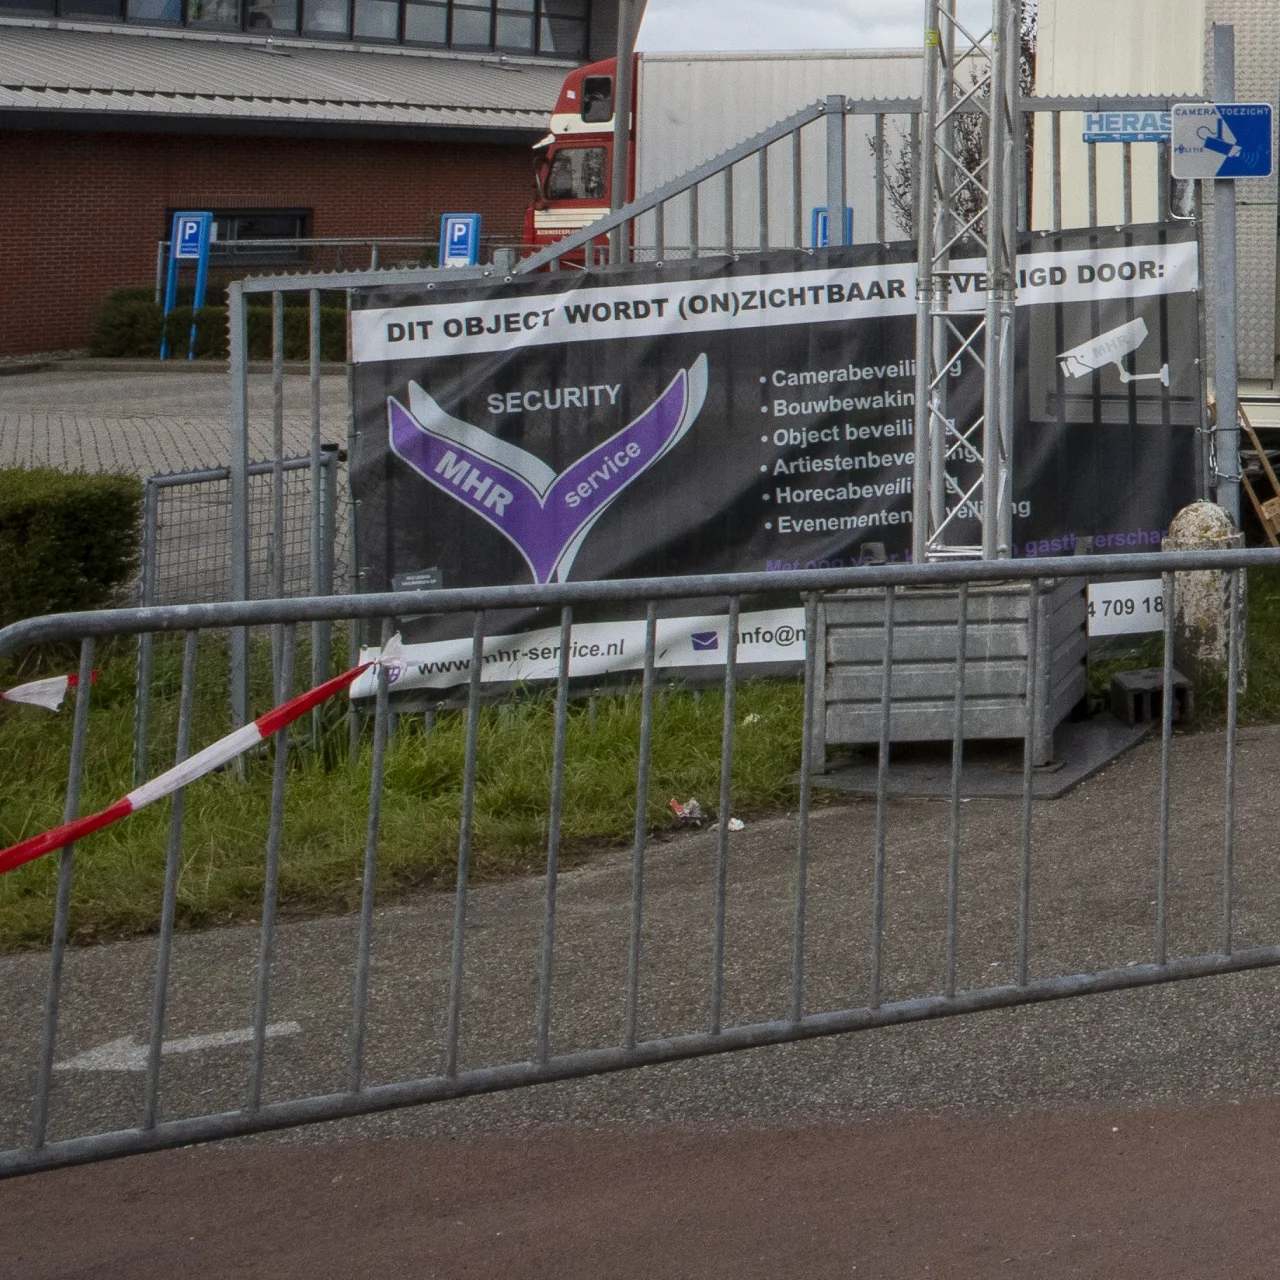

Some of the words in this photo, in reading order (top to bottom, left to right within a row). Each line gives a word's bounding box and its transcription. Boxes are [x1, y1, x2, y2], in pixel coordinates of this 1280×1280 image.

[1086, 113, 1171, 132] HERAS
[1175, 108, 1217, 116] CAMERA
[1220, 107, 1270, 116] TOEZICHT
[185, 222, 197, 240] P
[454, 224, 466, 242] P
[387, 320, 434, 343] DIT
[443, 308, 555, 338] OBJECT
[564, 298, 669, 324] WORDT
[679, 278, 907, 320] (ON)ZICHTBAAR
[916, 266, 1067, 296] VEIGD
[1077, 260, 1166, 284] DOOR:
[772, 358, 963, 388] Camerabeveilig
[487, 383, 622, 414] SECURITY
[774, 390, 916, 417] Bouwbewakin
[773, 426, 842, 448] Object
[845, 417, 957, 441] beveilig
[773, 442, 978, 476] Artiestenbeveing
[434, 450, 515, 517] MHR
[564, 439, 642, 508] service
[776, 473, 958, 505] Horecabeveilig
[778, 497, 1031, 534] Evenementenveiling
[419, 638, 625, 675] wwwmhr-serice.nl
[1102, 598, 1135, 617] 709
